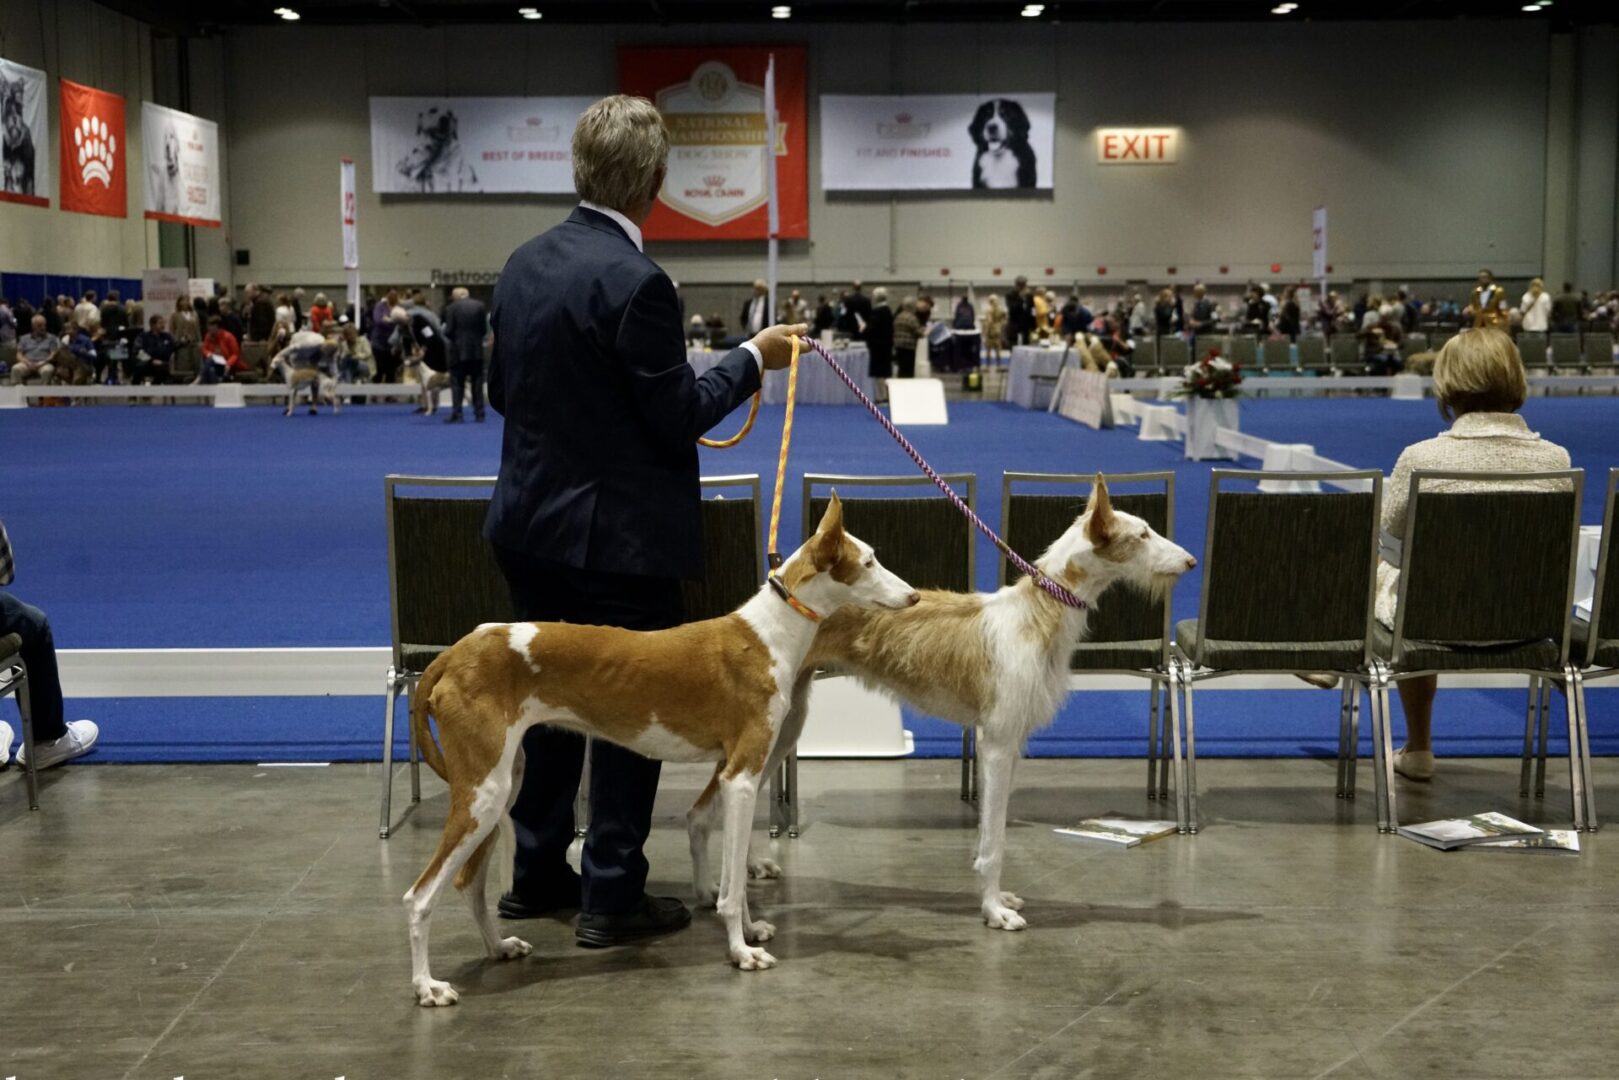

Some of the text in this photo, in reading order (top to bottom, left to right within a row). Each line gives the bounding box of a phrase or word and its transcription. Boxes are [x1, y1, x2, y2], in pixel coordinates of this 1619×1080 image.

[481, 150, 509, 161] BEST
[511, 150, 525, 161] OF
[1103, 133, 1170, 160] EXIT
